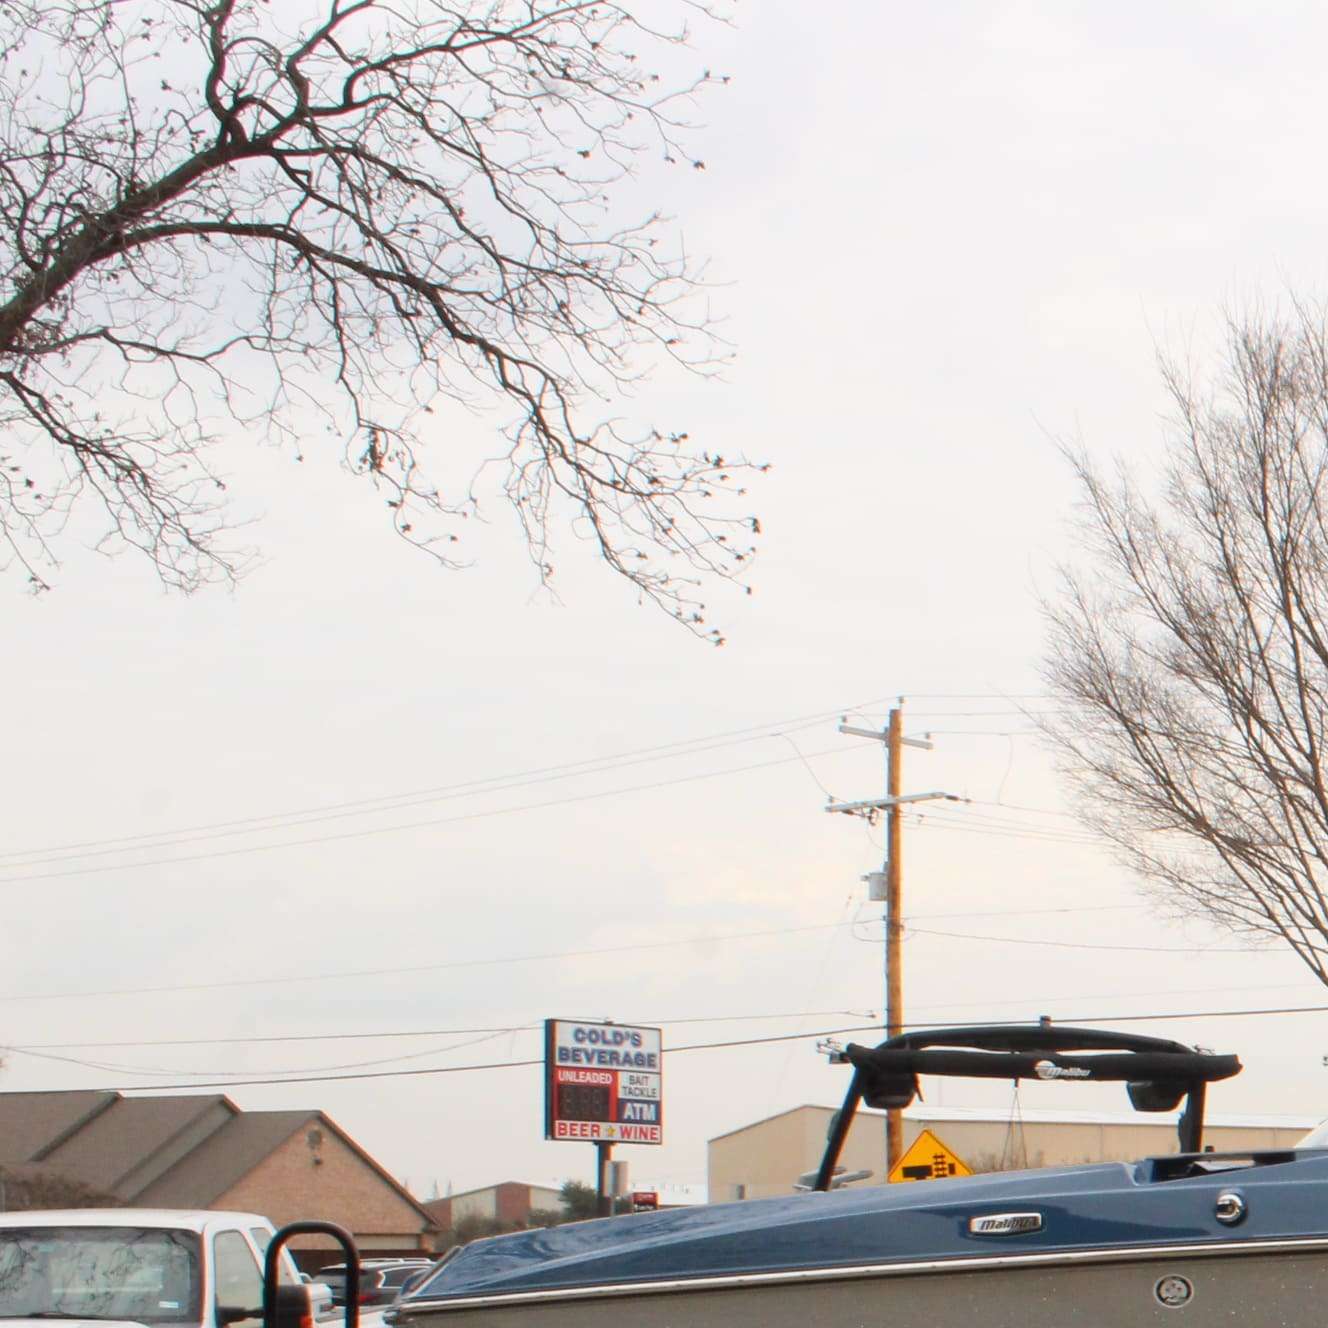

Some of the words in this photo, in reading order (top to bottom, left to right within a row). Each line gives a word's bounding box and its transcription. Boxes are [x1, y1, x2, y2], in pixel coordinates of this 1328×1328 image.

[573, 1027, 642, 1048] COLD'S
[557, 1046, 657, 1068] BEVERAGE
[557, 1070, 613, 1084] UNLEADED
[629, 1074, 650, 1087] BAIT
[622, 1086, 657, 1098] TACKLE
[623, 1102, 656, 1121] ATM
[558, 1122, 600, 1137] BEER
[620, 1125, 659, 1140] WINE
